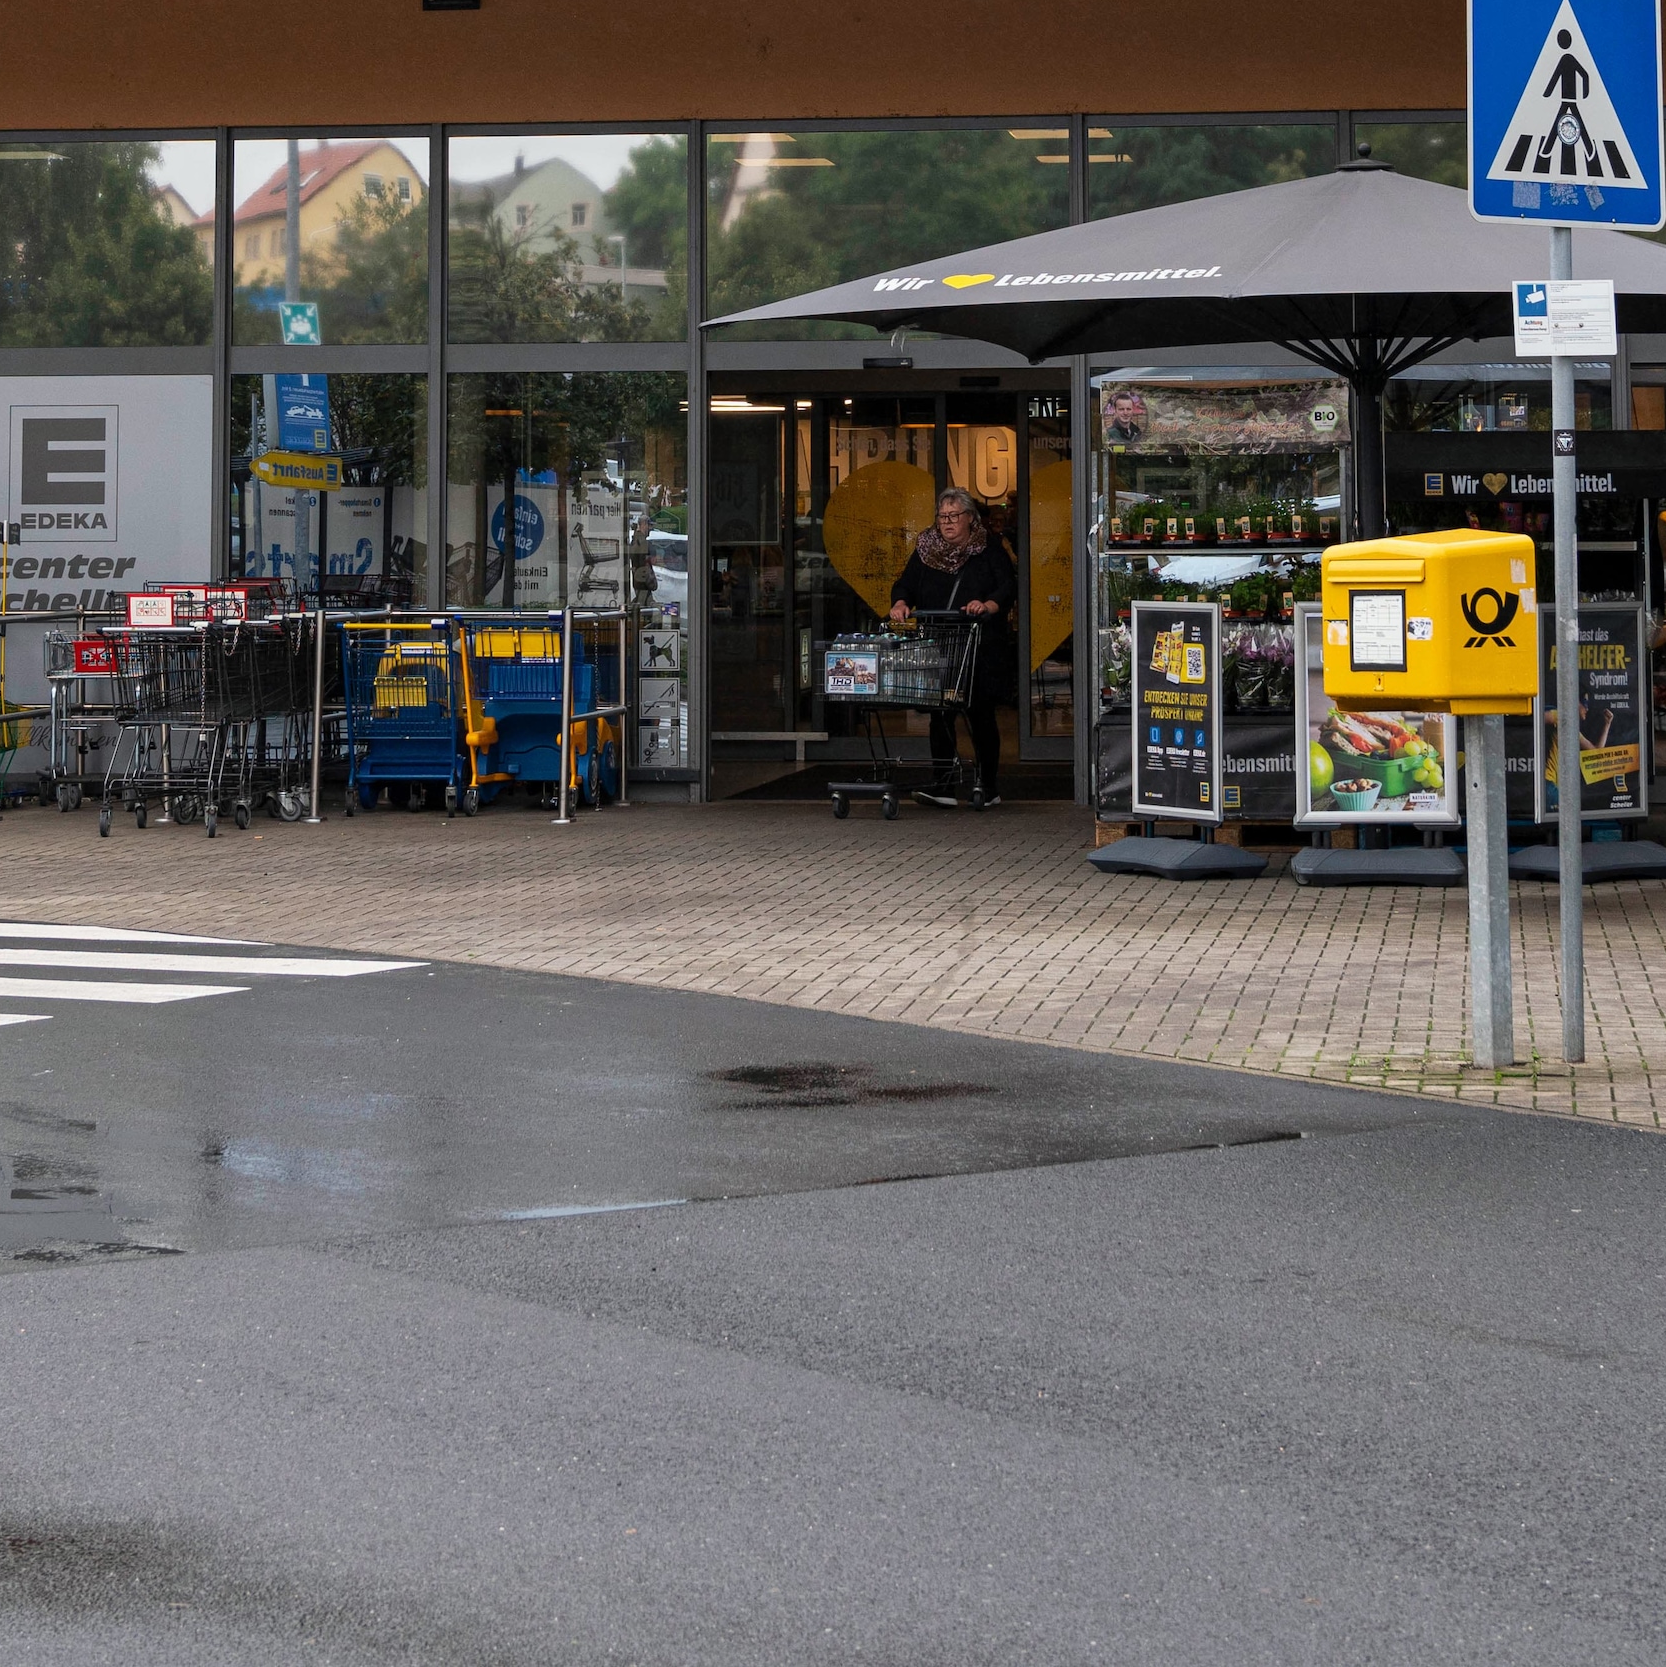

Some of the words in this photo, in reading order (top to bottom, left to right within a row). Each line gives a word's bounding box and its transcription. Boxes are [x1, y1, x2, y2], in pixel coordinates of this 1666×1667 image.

[872, 277, 935, 292] Wir
[993, 265, 1223, 288] Lebensmittel.
[1033, 436, 1071, 450] unser
[1451, 474, 1480, 495] Wir
[1510, 472, 1617, 495] Lebenittel.
[20, 512, 108, 530] EDEKA
[1595, 627, 1610, 642] das
[1549, 644, 1632, 670] AHELFER-
[1589, 671, 1629, 690] Syndrom!
[1144, 689, 1180, 705] ENTDECKEN
